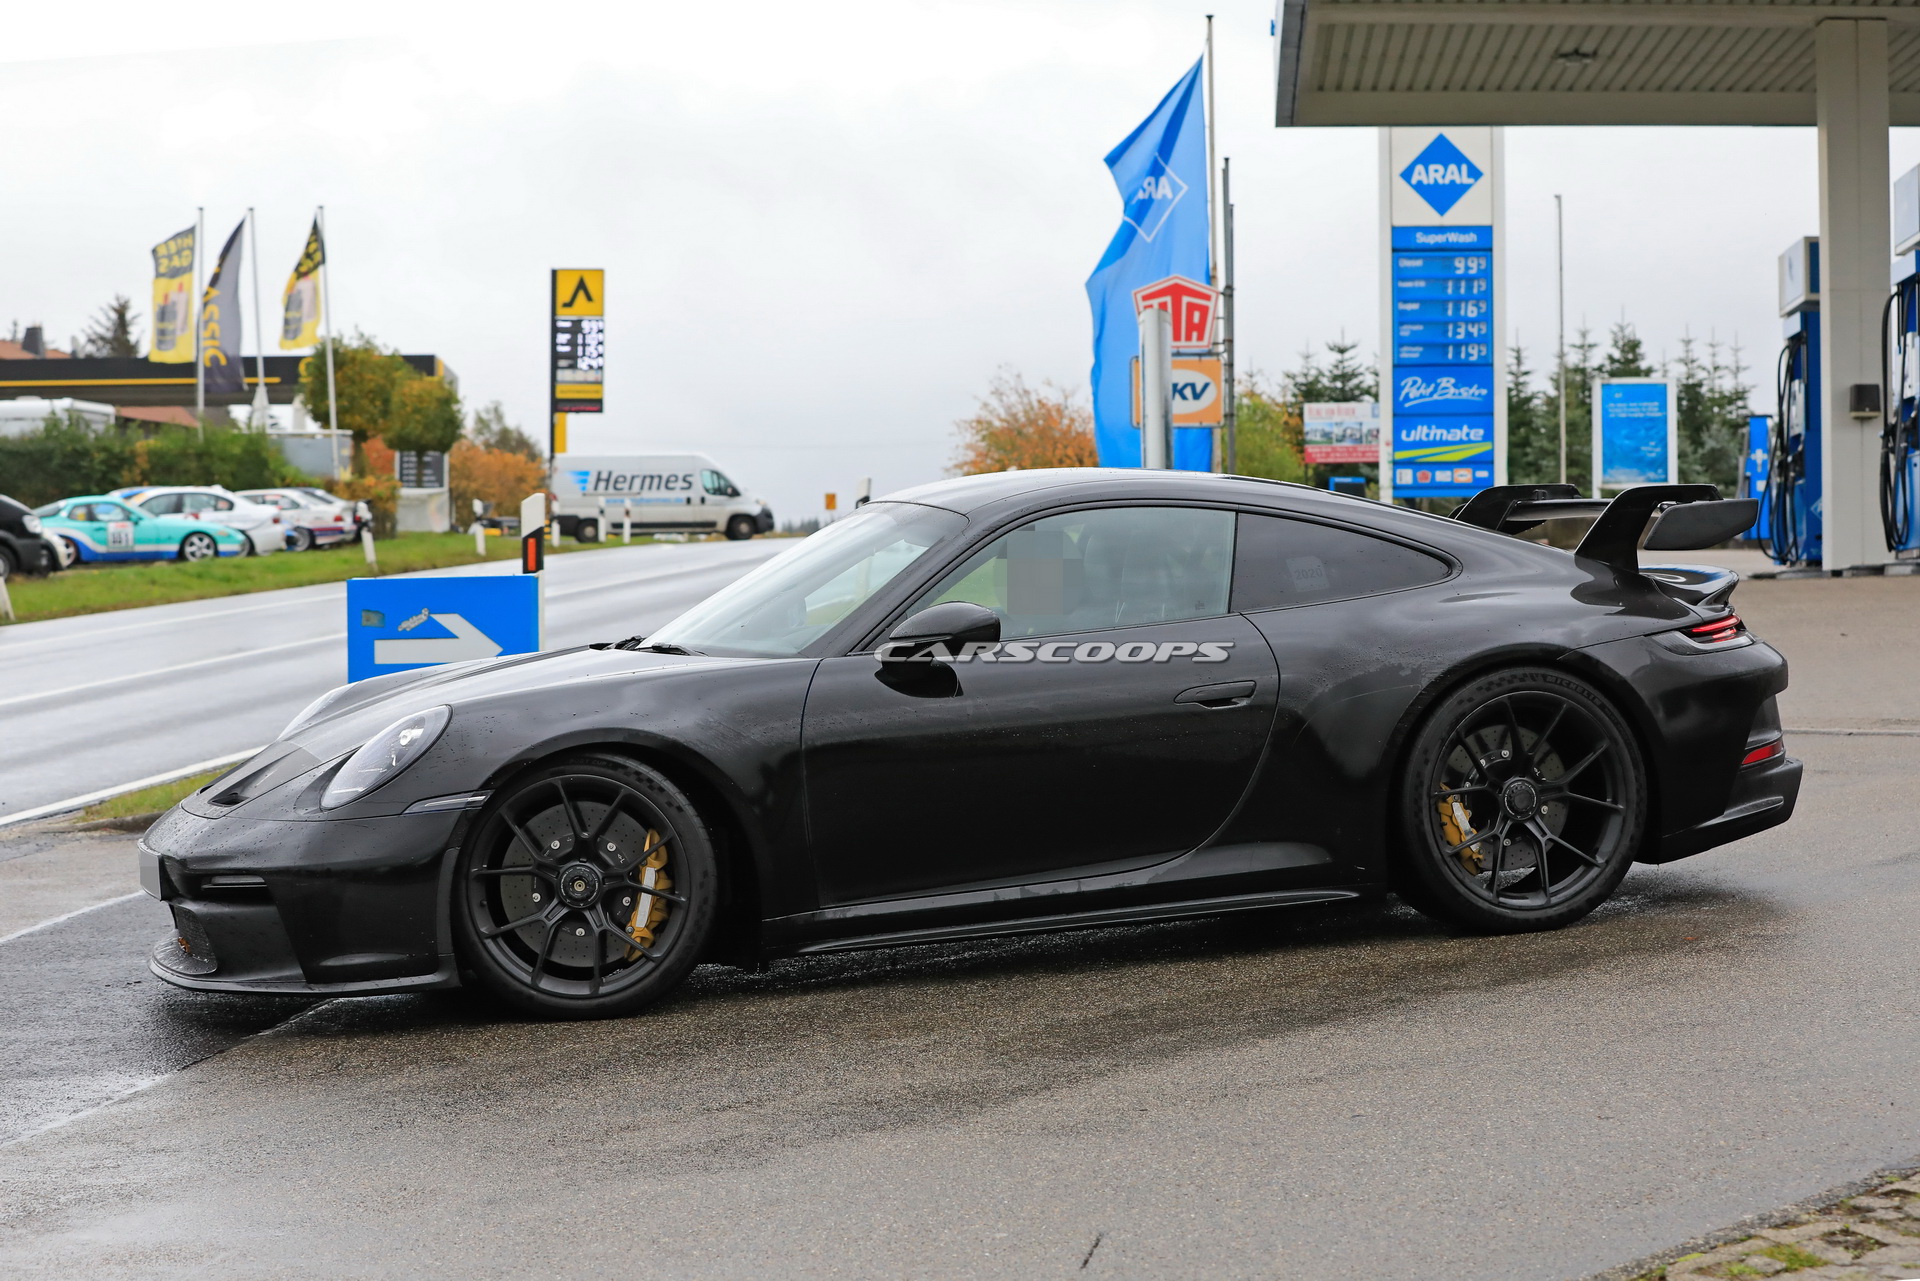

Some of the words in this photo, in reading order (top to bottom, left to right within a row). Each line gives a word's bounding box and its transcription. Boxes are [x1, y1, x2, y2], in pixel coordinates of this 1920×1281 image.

[1411, 163, 1475, 186] ARAL
[1415, 232, 1478, 244] SuperWash
[1142, 282, 1212, 343] TA
[1447, 300, 1486, 318] 1169
[1447, 343, 1487, 361] 1199
[1172, 382, 1211, 401] KV
[1401, 424, 1485, 442] ultimate
[593, 470, 694, 492] Hermes
[1294, 567, 1323, 581] 2020
